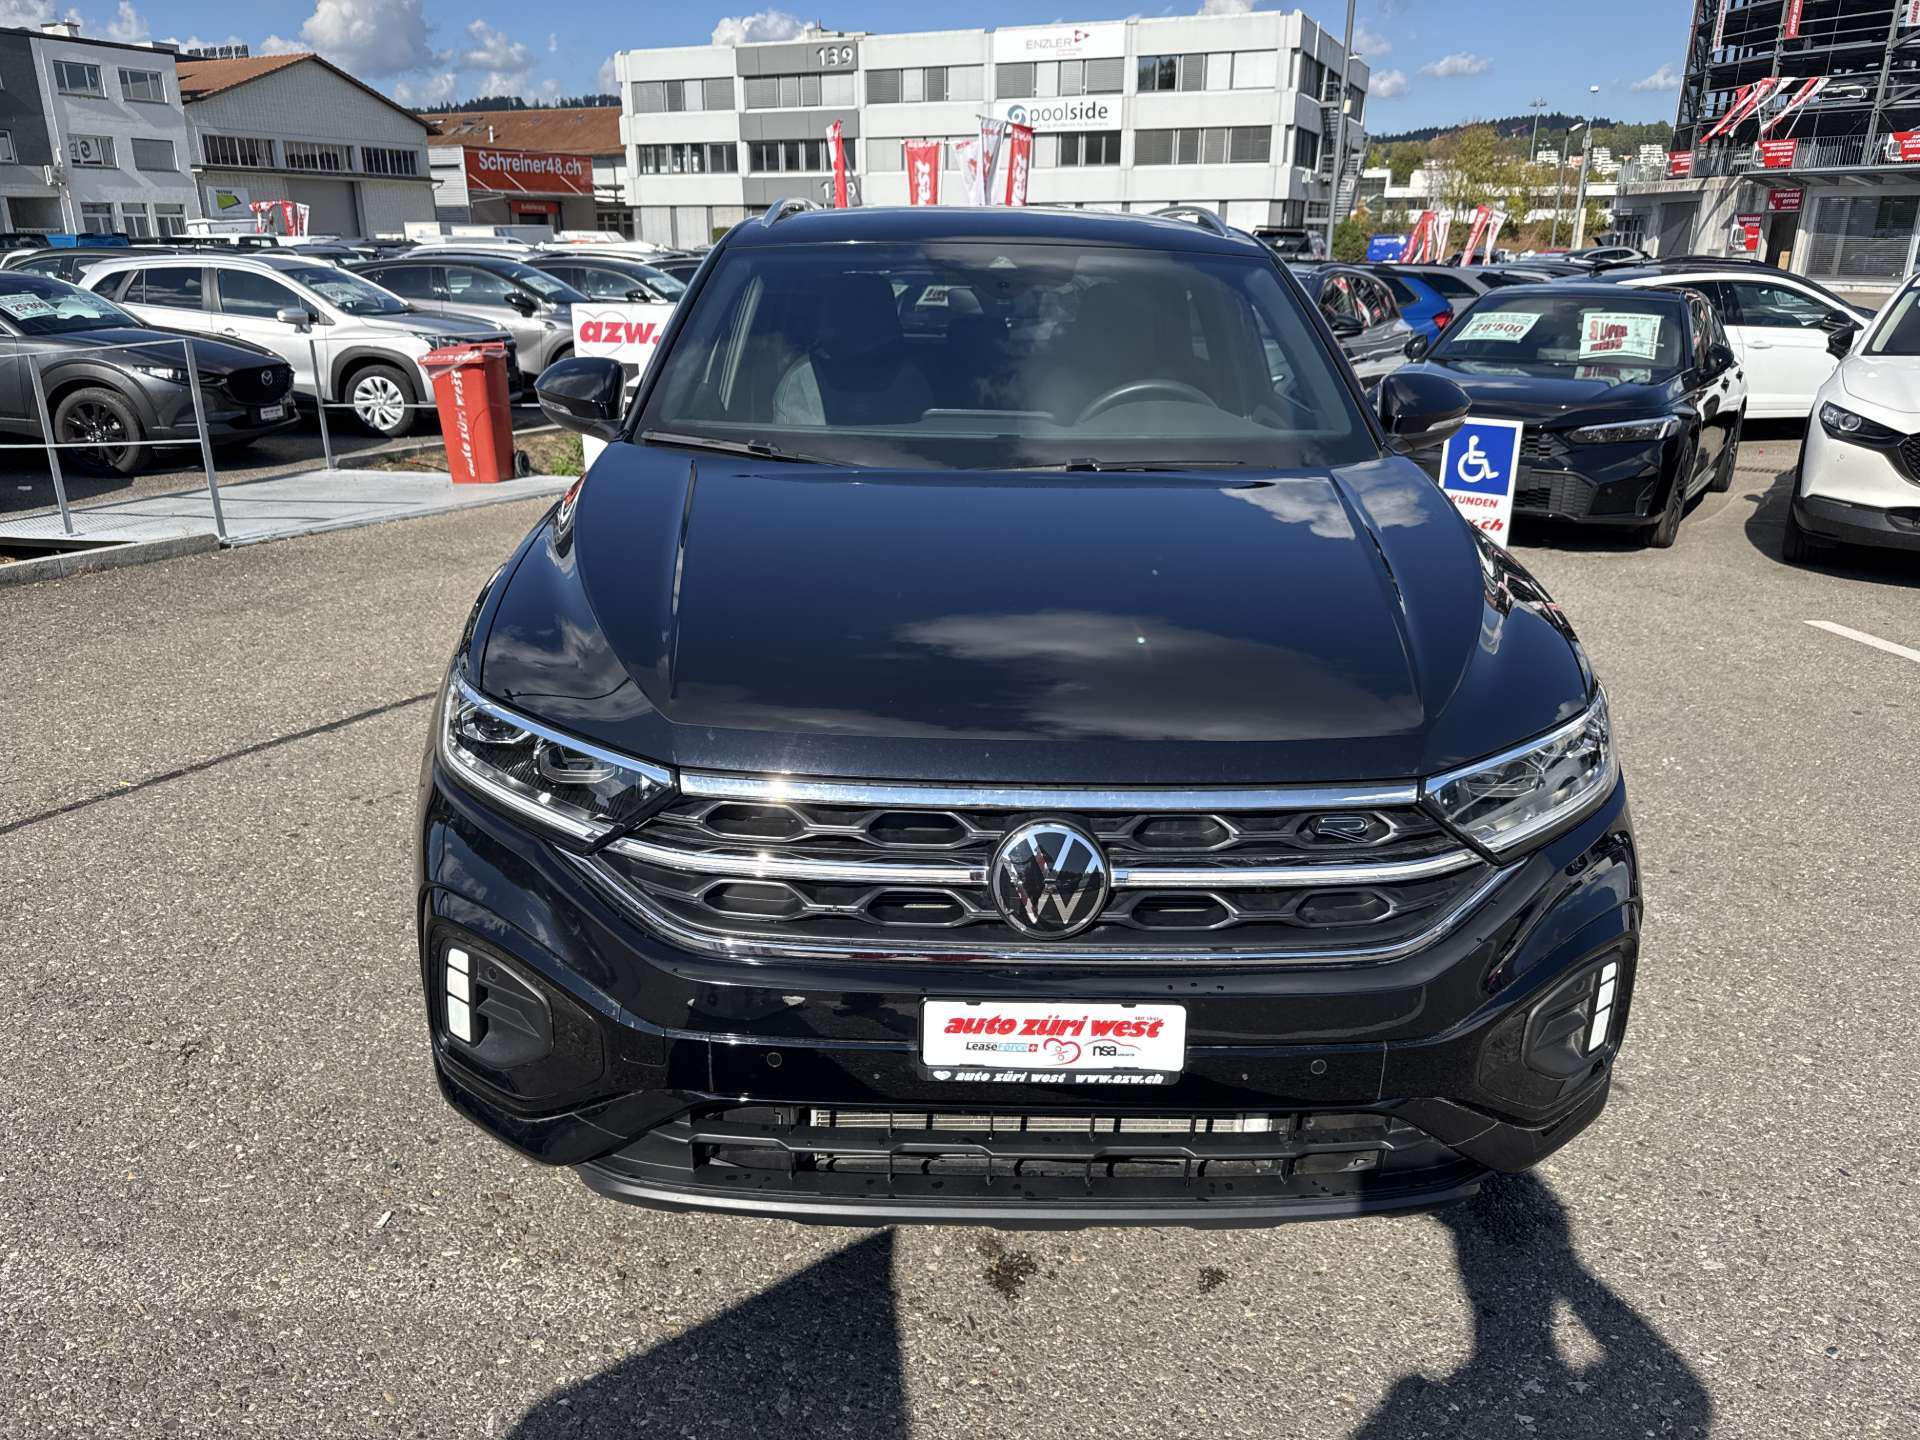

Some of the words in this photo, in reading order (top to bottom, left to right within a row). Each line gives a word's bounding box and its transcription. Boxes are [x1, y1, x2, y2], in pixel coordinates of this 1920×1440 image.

[1026, 37, 1073, 50] ENZLER
[816, 45, 853, 67] 139
[1030, 101, 1108, 128] poolside
[478, 150, 582, 176] Schreiner48.ch
[821, 181, 857, 200] 19
[1450, 494, 1499, 508] KUNDEN
[944, 1013, 1017, 1036] auto
[1018, 1013, 1088, 1037] züri
[1090, 1017, 1164, 1038] west
[1092, 1045, 1117, 1057] nsa
[954, 1071, 991, 1082] auto
[992, 1070, 1027, 1083] züri
[1030, 1072, 1067, 1083] west
[1075, 1073, 1164, 1084] www.azw.ch
